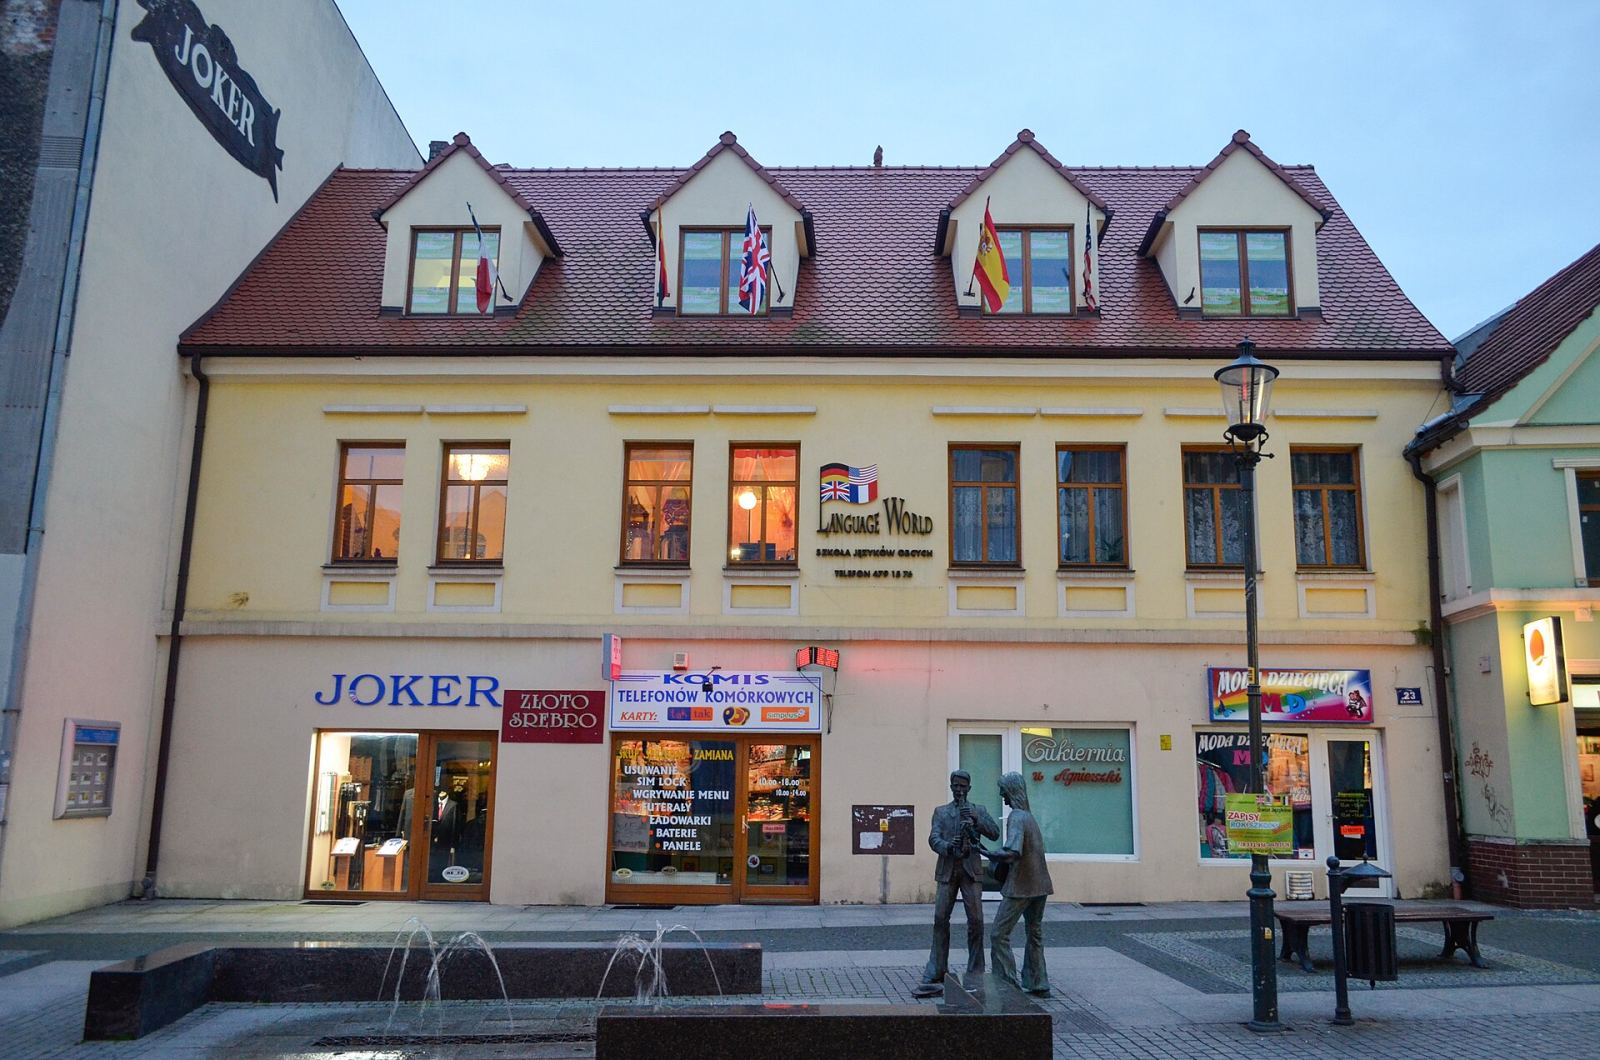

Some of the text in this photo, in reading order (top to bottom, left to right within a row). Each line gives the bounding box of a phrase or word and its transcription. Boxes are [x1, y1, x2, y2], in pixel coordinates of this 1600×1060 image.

[175, 24, 255, 147] JOKER
[816, 545, 933, 559] SZKOŁA JĘZYKÓW OBCYCH
[834, 569, 871, 579] TELEFON
[663, 673, 769, 685] KOMIS
[314, 673, 503, 708] JOKER
[617, 687, 814, 704] TELEFONÓW KOMÓRKOWYCH
[1402, 691, 1416, 700] 23
[519, 693, 590, 710] ZŁOTO
[509, 712, 598, 728] SREBRO
[620, 711, 658, 721] KARTY:
[693, 708, 711, 718] tak
[1024, 737, 1126, 763] Cukiernia
[1197, 734, 1233, 754] MODA
[694, 749, 734, 761] ZAMIANA
[624, 765, 678, 775] USUWANIE
[636, 777, 687, 786] SIM LOCK
[1054, 767, 1122, 787] Agnieszki
[633, 789, 730, 800] WGRYWANIE MENU
[642, 802, 692, 812] FUTERAŁY
[649, 815, 712, 826] ŁADOWARKI
[1227, 811, 1260, 821] ZAPISY
[655, 828, 697, 838] BATERIE
[662, 841, 701, 851] PANELE
